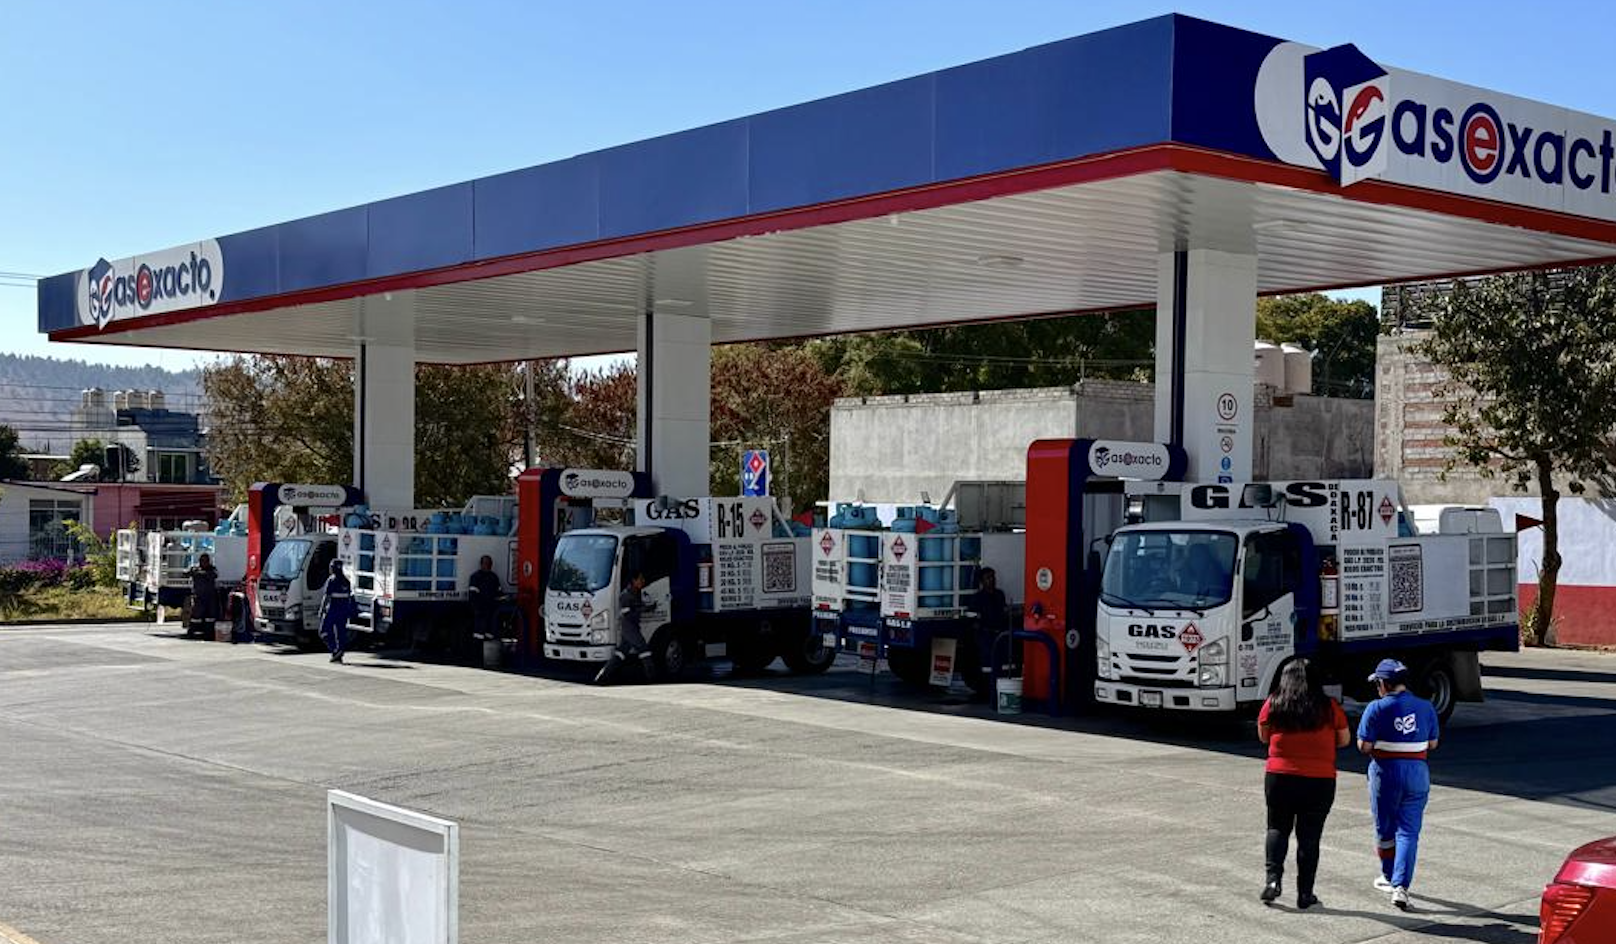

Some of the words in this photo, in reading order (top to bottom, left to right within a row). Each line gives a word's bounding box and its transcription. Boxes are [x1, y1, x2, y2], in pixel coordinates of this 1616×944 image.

[1222, 399, 1233, 411] 10
[1341, 491, 1373, 530] R-87
[717, 503, 744, 538] R-15
[557, 602, 580, 611] GAS
[1128, 624, 1176, 639] GAS
